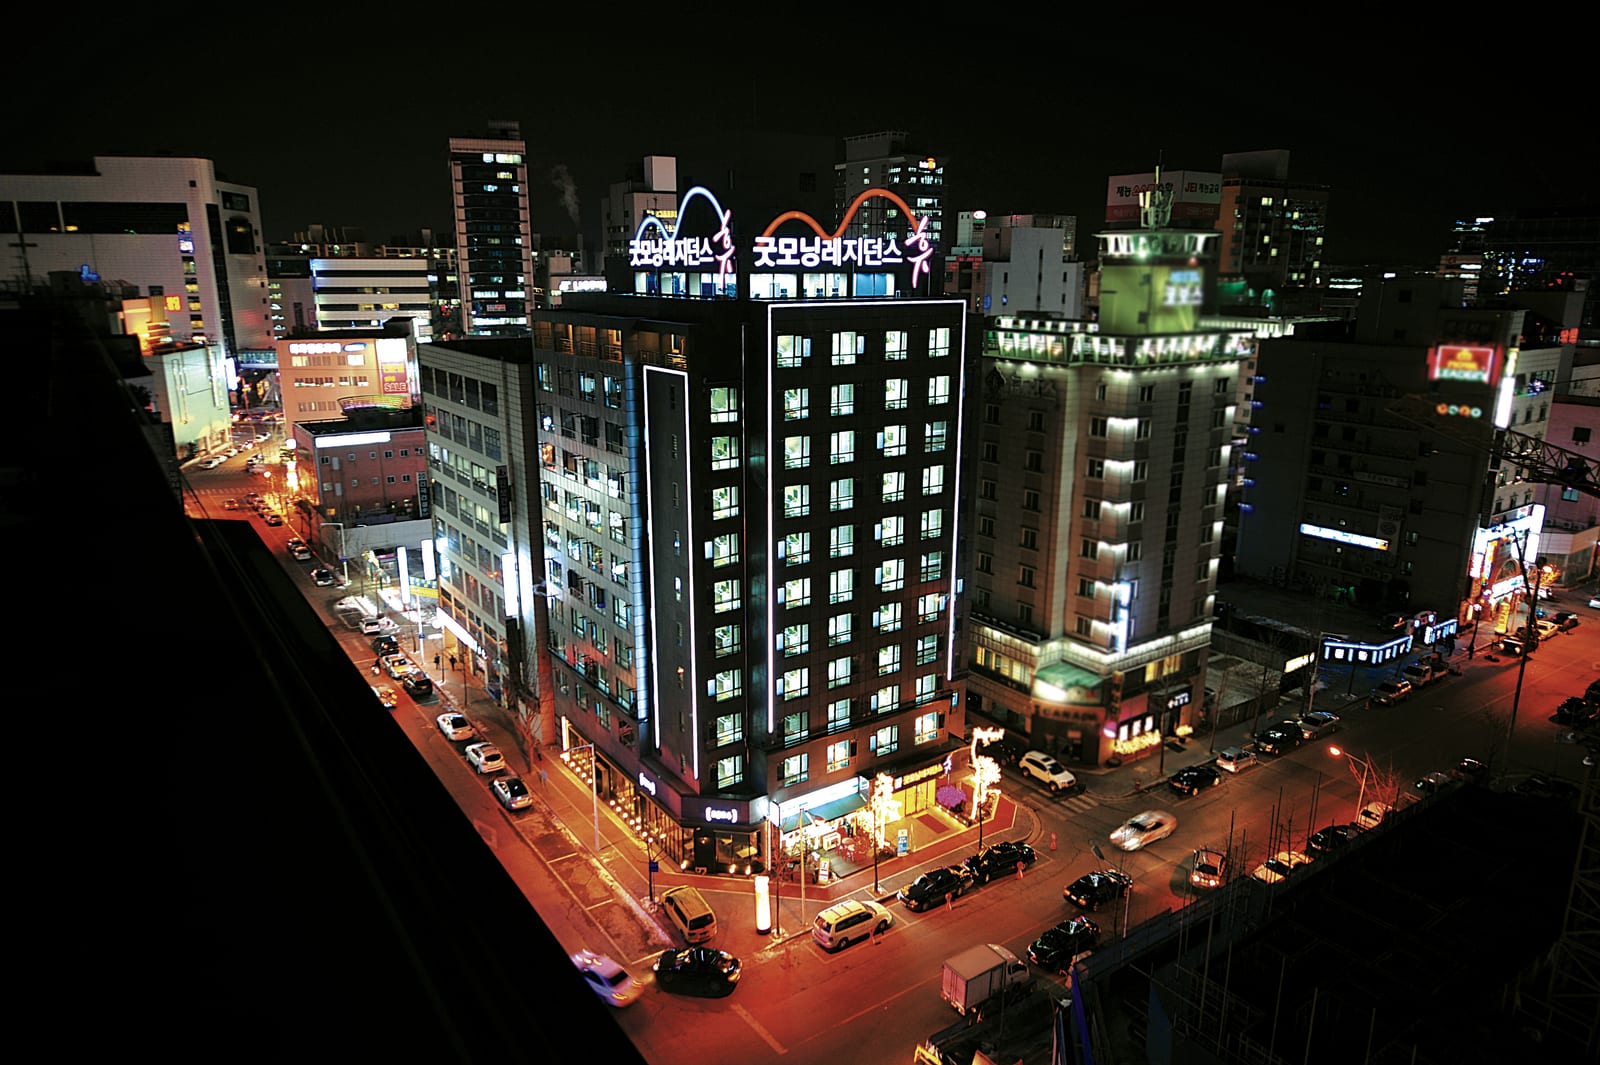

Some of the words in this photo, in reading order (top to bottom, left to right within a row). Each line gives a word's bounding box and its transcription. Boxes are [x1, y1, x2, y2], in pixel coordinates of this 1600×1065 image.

[1184, 182, 1197, 193] JEI
[628, 237, 714, 267] 굿모닝레지던스
[752, 236, 903, 267] 굿모닝레지던스
[384, 382, 407, 393] SALE
